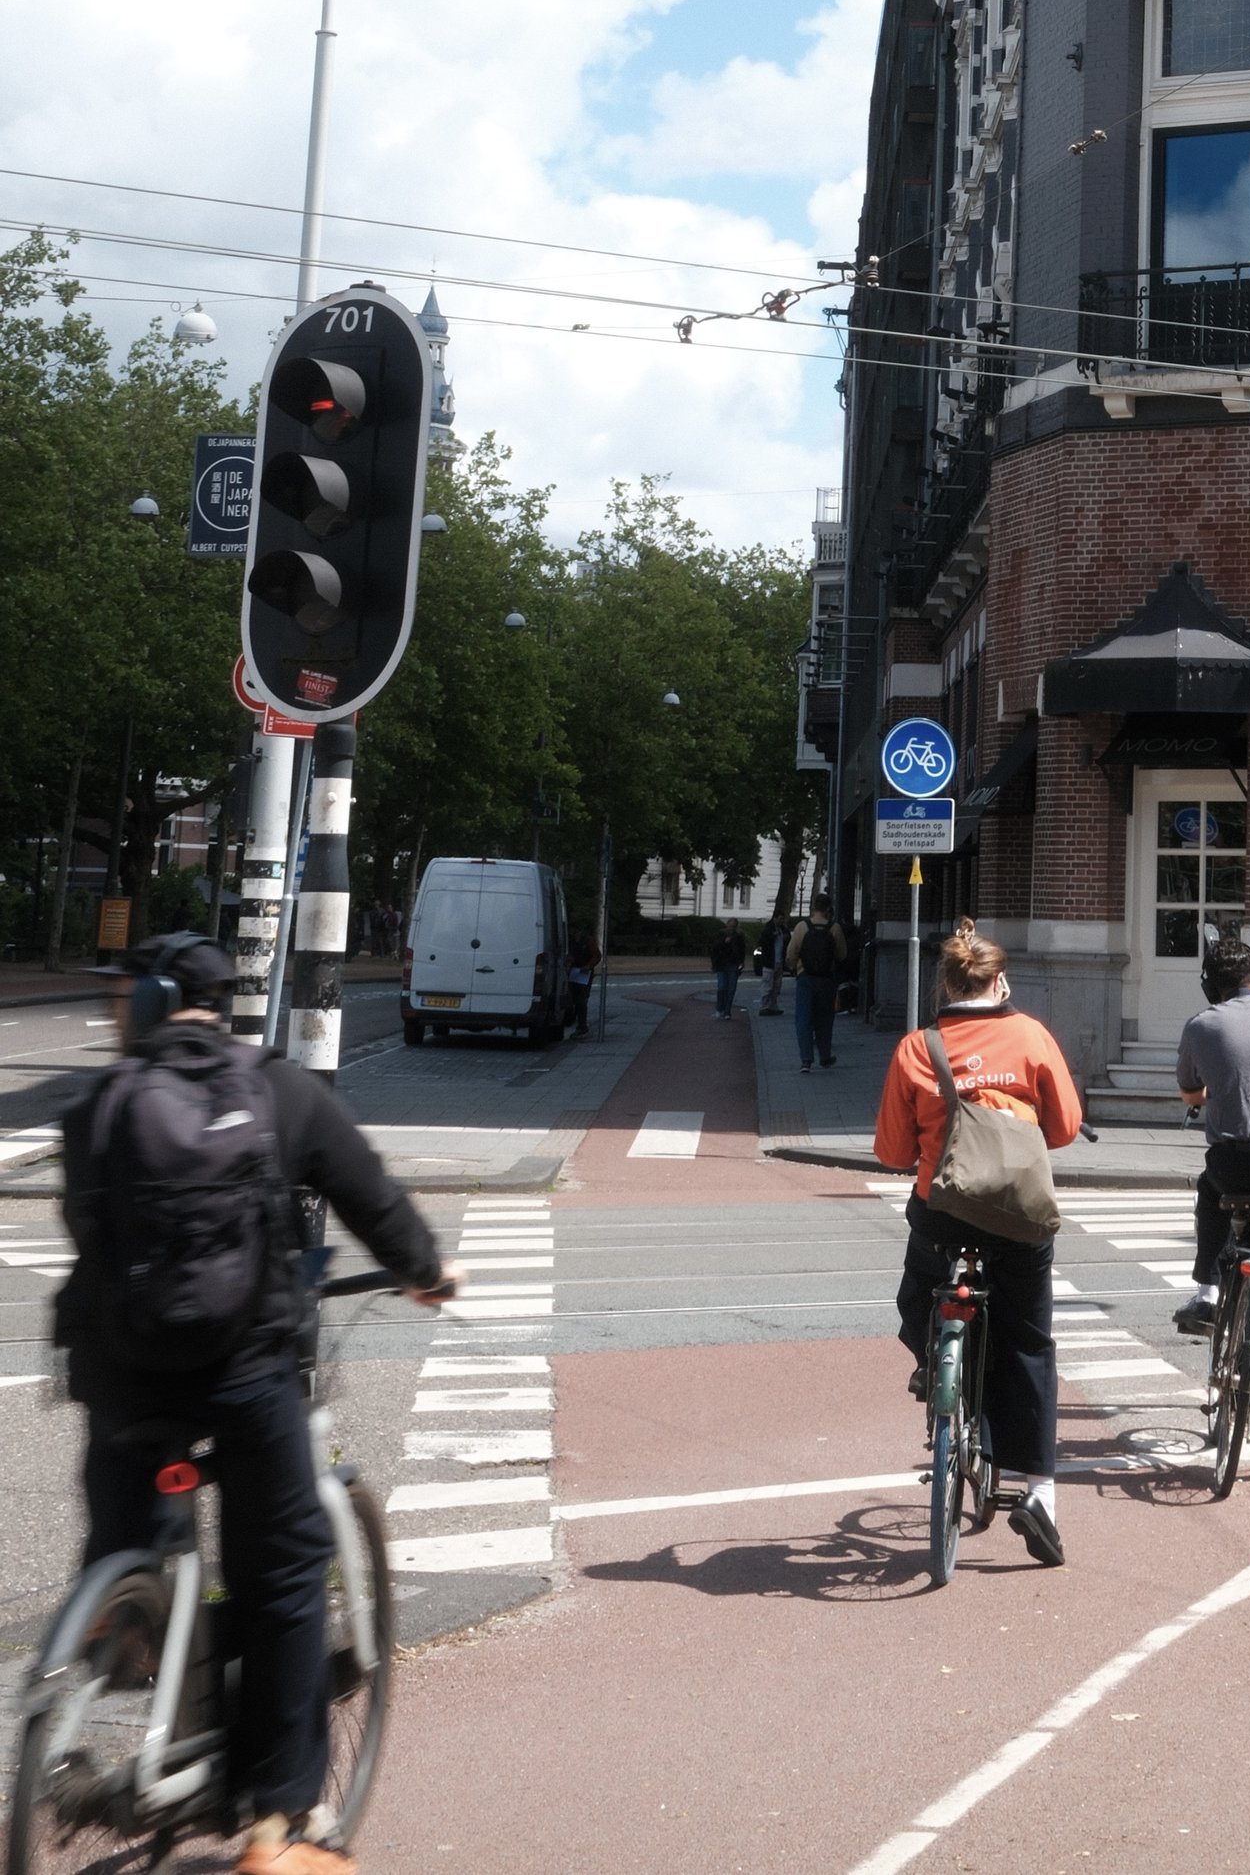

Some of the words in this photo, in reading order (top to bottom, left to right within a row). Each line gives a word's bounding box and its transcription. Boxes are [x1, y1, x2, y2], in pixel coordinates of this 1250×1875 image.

[325, 306, 374, 333] 701
[229, 471, 244, 484] DE
[191, 543, 217, 552] ALBERT
[1118, 737, 1217, 753] MOMO
[886, 821, 931, 830] Snorfietsen
[933, 823, 942, 831] op
[882, 830, 946, 838] Stadhouderskade
[892, 840, 902, 848] op
[904, 839, 935, 848] fietspad
